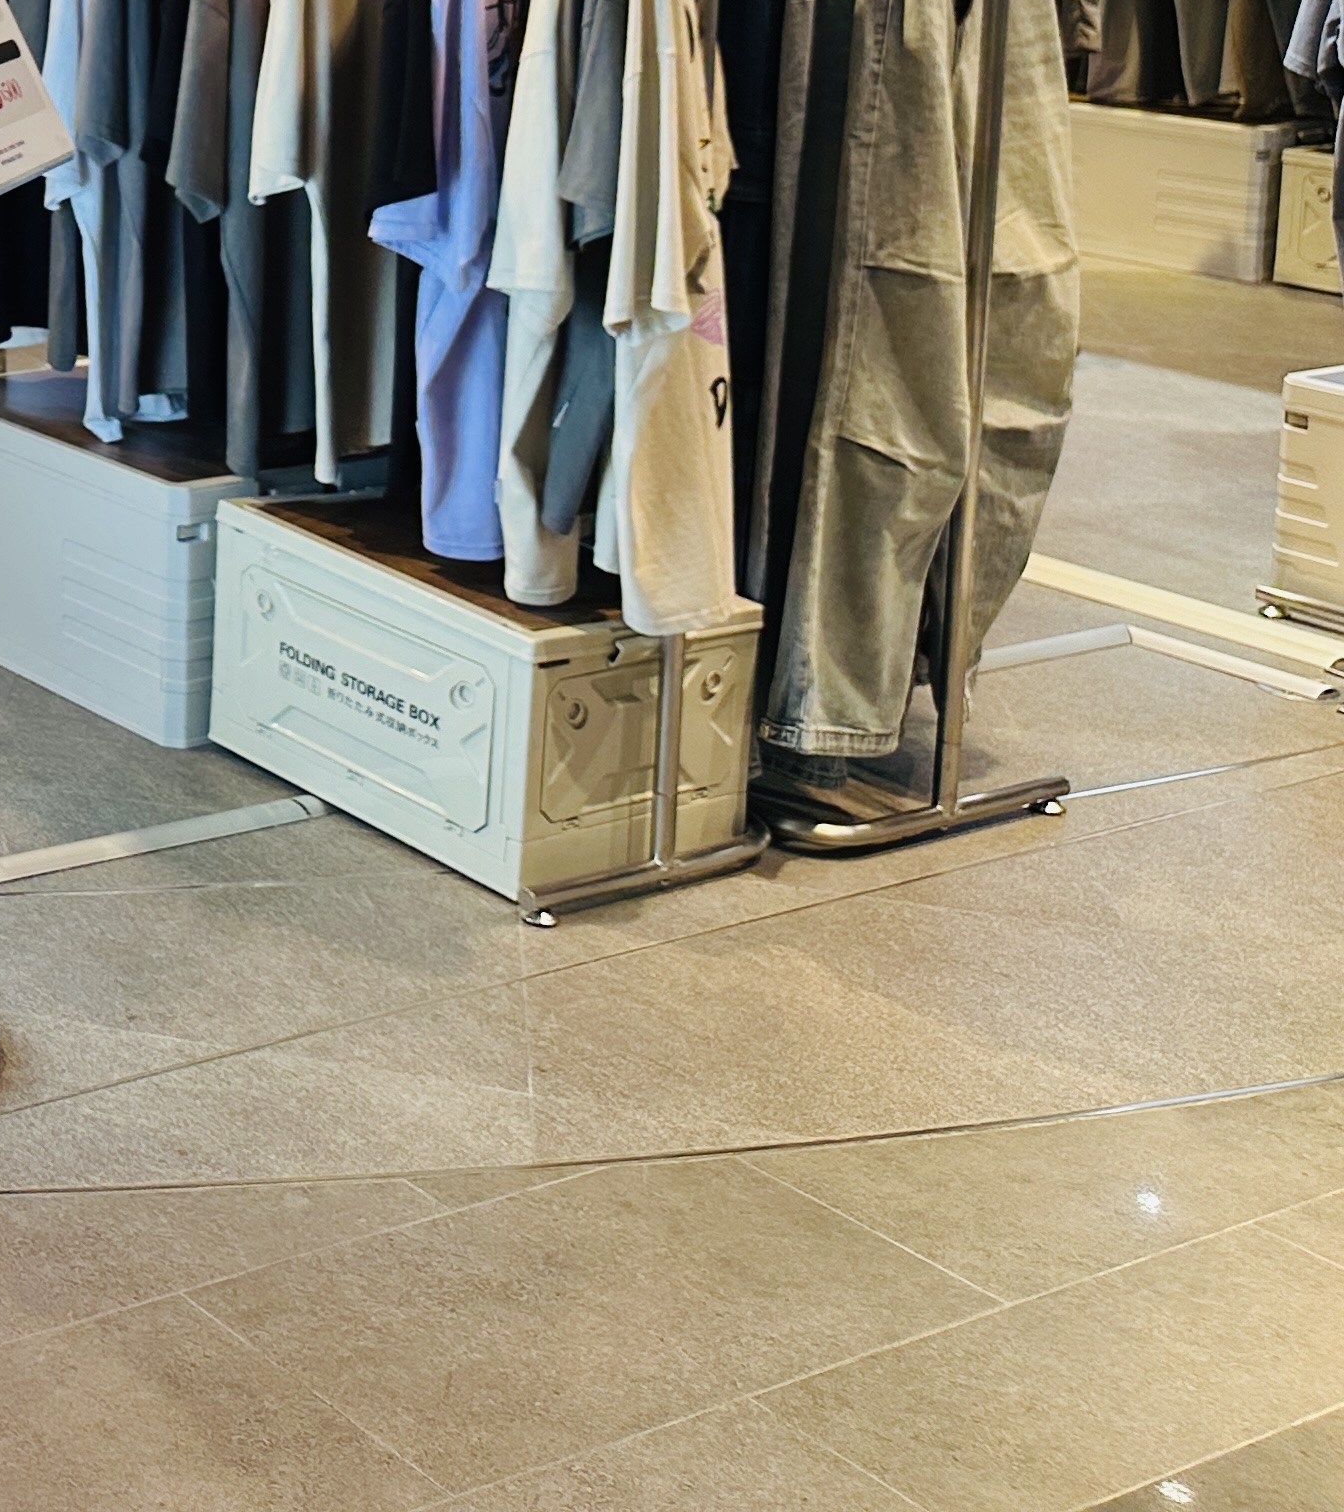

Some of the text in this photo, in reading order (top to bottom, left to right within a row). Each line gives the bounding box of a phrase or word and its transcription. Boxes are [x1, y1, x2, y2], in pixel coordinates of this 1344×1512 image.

[279, 641, 441, 730] FOLDING STORAGE BOX
